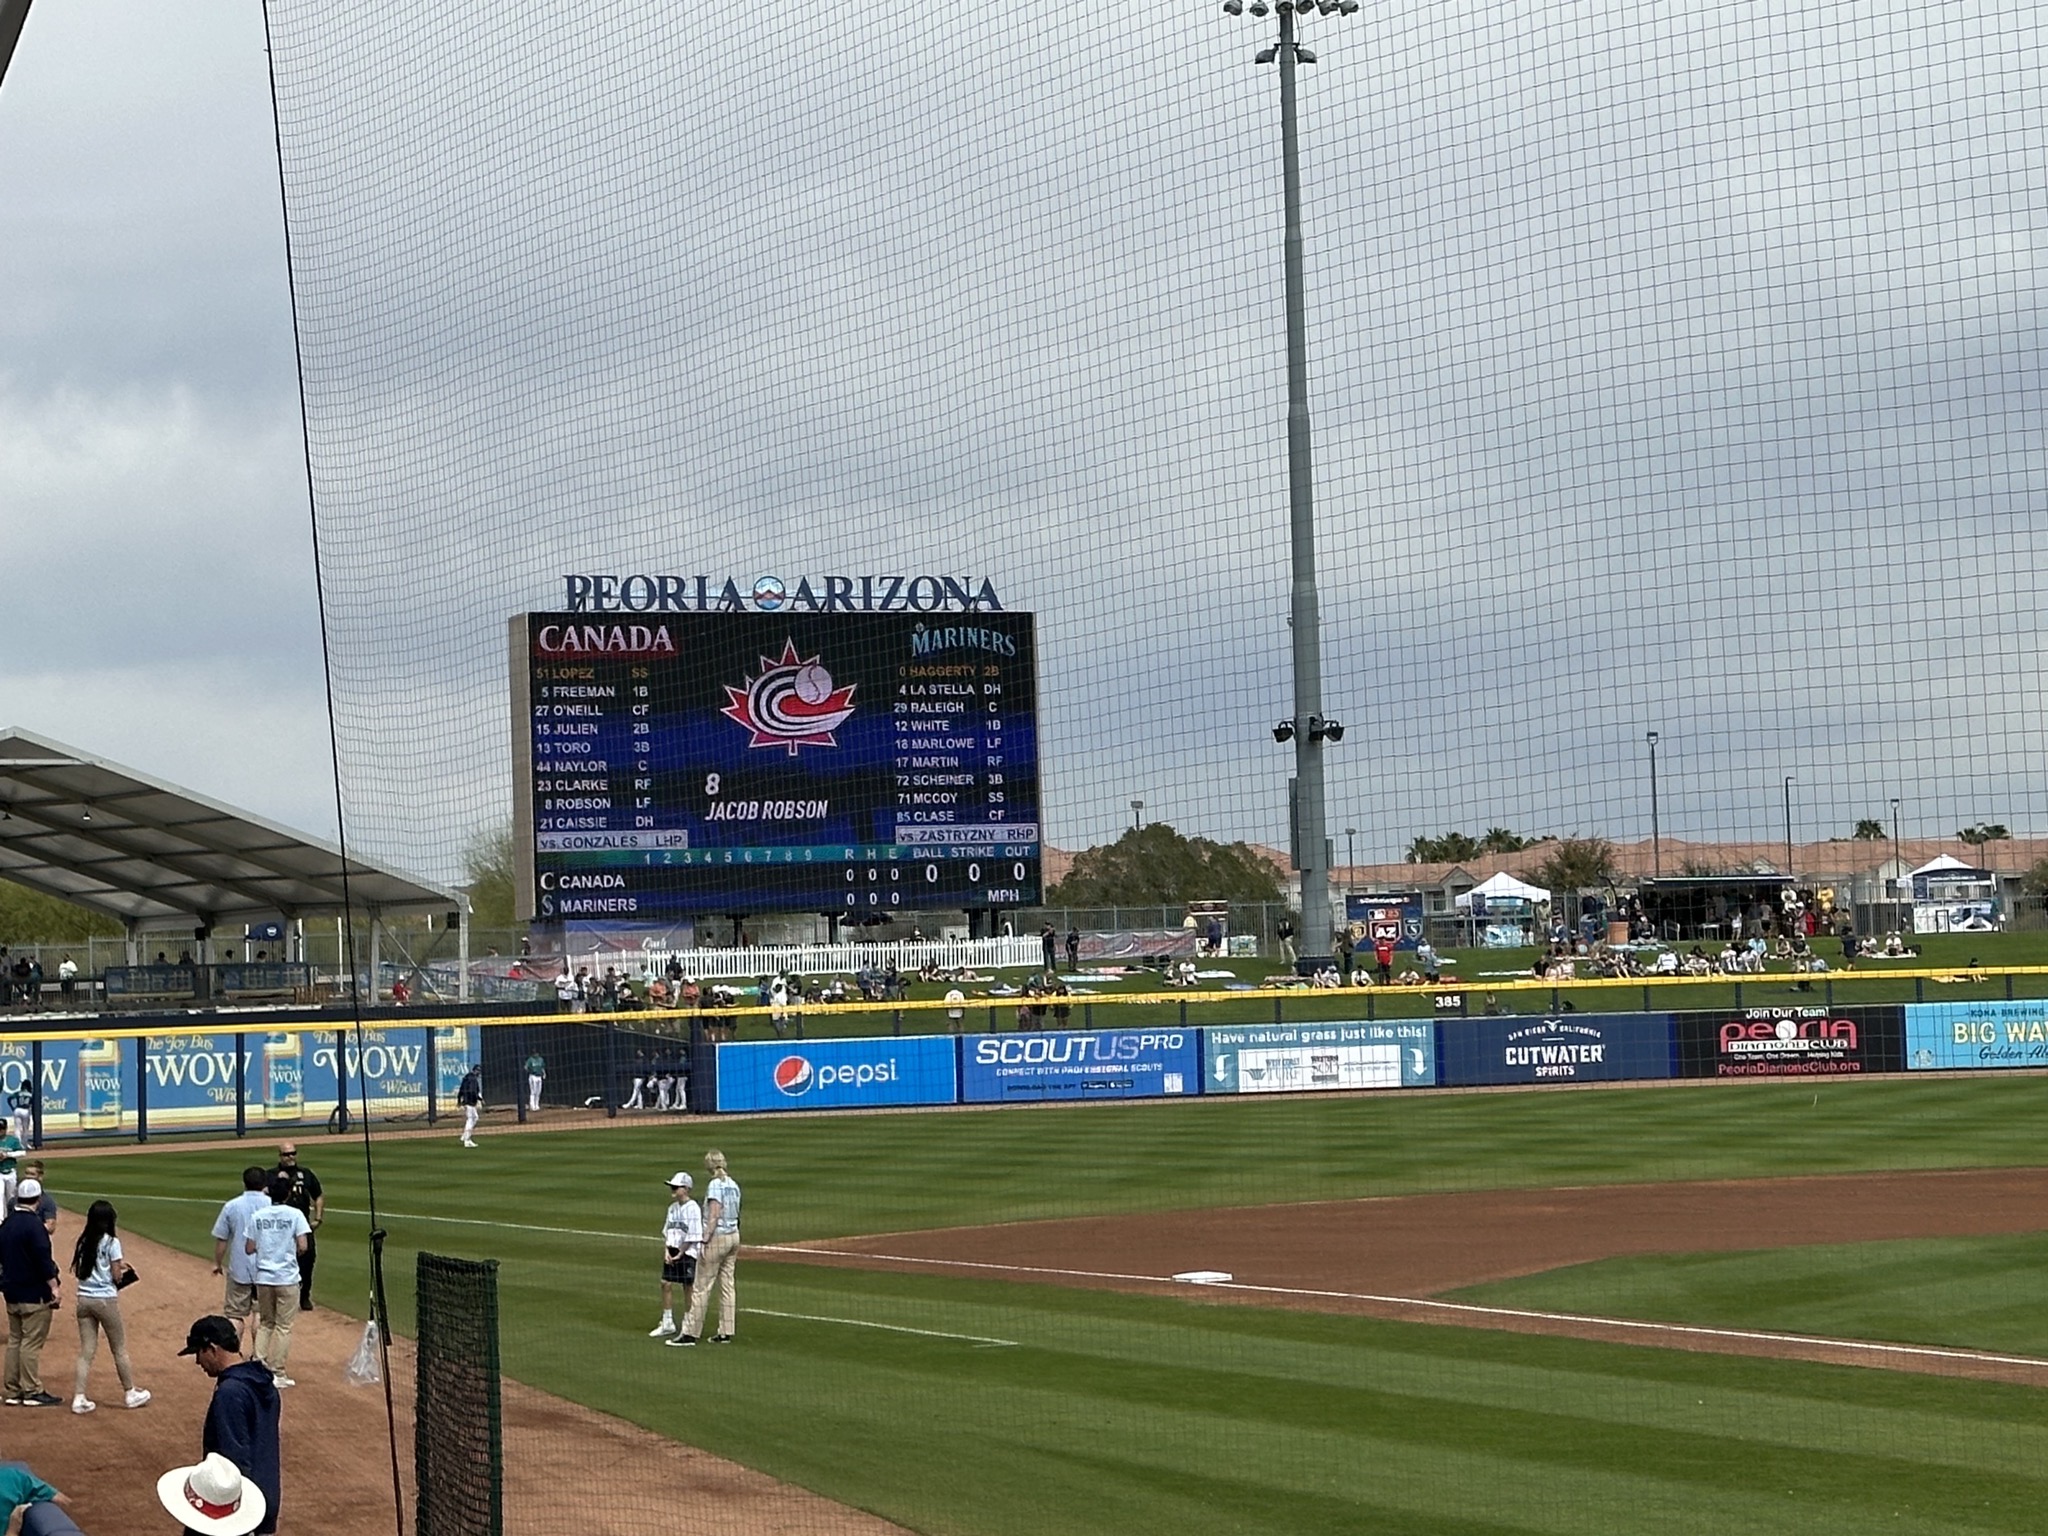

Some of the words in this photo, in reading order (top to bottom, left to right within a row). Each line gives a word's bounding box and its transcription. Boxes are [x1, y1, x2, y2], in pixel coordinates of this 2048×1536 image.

[563, 575, 748, 611] PEORIA
[790, 576, 1004, 611] ARIZONA
[539, 625, 675, 652] CANADA
[912, 626, 1015, 657] MARINERS
[553, 668, 595, 679] LOPEZ
[632, 667, 648, 678] SS
[900, 666, 906, 677] 0
[910, 665, 976, 677] HAGGERTY
[984, 665, 1000, 676] 2B
[542, 687, 549, 698] 5
[554, 686, 615, 698] FREEMAN
[633, 686, 649, 697] 1B
[900, 684, 907, 695] 4
[910, 684, 926, 695] LA
[929, 683, 975, 695] STELLA
[984, 683, 1001, 695] DH
[536, 705, 550, 717] 27
[554, 705, 603, 716] O'NEILL
[633, 704, 649, 716] CF
[894, 702, 908, 713] 29
[911, 702, 964, 713] RALEIGH
[988, 702, 998, 713] C
[537, 724, 551, 735] 15
[554, 723, 598, 735] JULIEN
[633, 723, 650, 734] 2B
[895, 720, 908, 731] 12
[911, 720, 950, 731] WHITE
[986, 720, 1001, 731] 1B
[537, 743, 550, 754] 13
[554, 742, 591, 754] TORO
[634, 741, 650, 752] 3B
[911, 738, 975, 749] MARLOWE
[987, 738, 1002, 749] LF
[536, 762, 551, 772] 44
[555, 761, 607, 772] NAYLOR
[638, 760, 647, 771] C
[896, 757, 909, 768] 17
[912, 757, 959, 768] MARTIN
[987, 756, 1003, 767] RF
[537, 780, 551, 791] 23
[555, 780, 608, 791] CLARKE
[635, 779, 651, 790] RF
[705, 773, 720, 795] 8
[896, 775, 910, 786] 72
[913, 774, 975, 786] SCHEINER
[988, 774, 1003, 785] 3B
[545, 799, 552, 810] 8
[556, 798, 611, 810] ROBSON
[636, 797, 651, 809] LF
[898, 794, 911, 805] 71
[913, 793, 958, 804] MCCOY
[988, 792, 1004, 803] SS
[704, 801, 759, 821] JACOB
[762, 800, 828, 820] ROBSON
[914, 811, 955, 822] CLASE
[989, 810, 1005, 821] CF
[540, 818, 553, 829] 21
[556, 817, 607, 829] CAISSIE
[636, 816, 653, 828] DH
[919, 830, 996, 842] ZASTRYZNY
[1007, 828, 1033, 840] RHP
[562, 836, 638, 849] GONZALES
[655, 835, 682, 847] LHP
[644, 854, 651, 864] 1
[663, 853, 672, 864] 2
[684, 852, 692, 863] 3
[704, 852, 712, 863] 4
[724, 851, 732, 862] 5
[745, 851, 753, 862] 6
[765, 850, 772, 861] 7
[785, 850, 792, 861] 8
[805, 850, 812, 861] 9
[845, 849, 854, 860] R
[867, 849, 876, 860] H
[889, 848, 897, 859] E
[913, 848, 945, 859] BALL
[951, 846, 995, 858] STRIKE
[1005, 846, 1030, 857] OUT
[559, 874, 626, 889] CANADA
[846, 868, 854, 881] 0
[868, 868, 877, 881] 0
[891, 868, 899, 880] 0
[926, 864, 938, 883] 0
[968, 863, 980, 882] 0
[1013, 862, 1025, 880] 0
[560, 898, 638, 913] MARINERS
[847, 892, 855, 905] 0
[869, 892, 878, 905] 0
[892, 892, 900, 904] 0
[988, 889, 1020, 903] MPH
[1435, 996, 1462, 1008] 385
[1746, 1008, 1770, 1019] Join
[1772, 1007, 1793, 1018] Our
[362, 1028, 386, 1043] Bus
[1211, 1032, 1245, 1044] Have
[1249, 1029, 1298, 1043] natural
[1301, 1030, 1337, 1044] grass
[1340, 1027, 1366, 1042] just
[1369, 1026, 1394, 1040] like
[1397, 1025, 1427, 1039] this!
[1953, 1021, 1997, 1044] BIG
[166, 1034, 188, 1053] Joy
[190, 1034, 214, 1051] Bus
[1505, 1044, 1604, 1066] CUTWATER
[1979, 1045, 2023, 1060] Golden
[313, 1045, 422, 1080] WOW
[146, 1052, 252, 1087] WOW
[819, 1058, 897, 1090] pepsi
[1535, 1065, 1575, 1077] SPIRITS
[0, 1058, 67, 1095] OW
